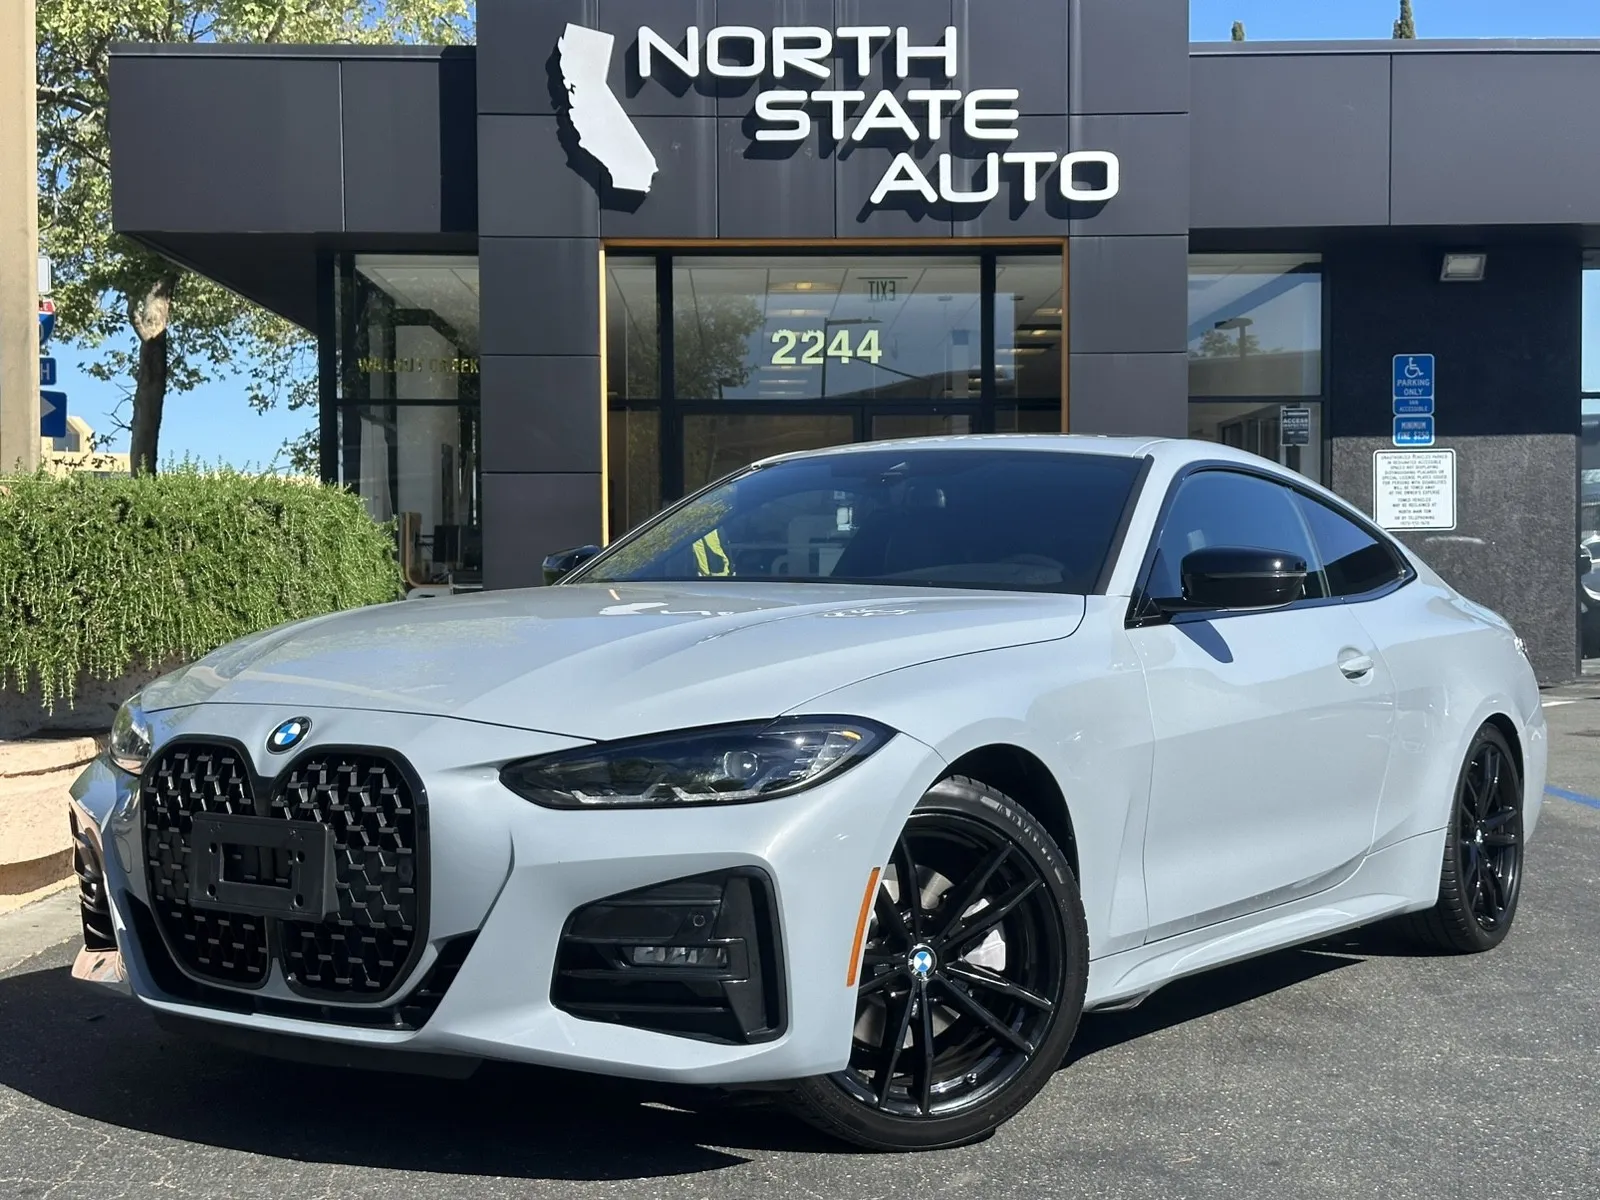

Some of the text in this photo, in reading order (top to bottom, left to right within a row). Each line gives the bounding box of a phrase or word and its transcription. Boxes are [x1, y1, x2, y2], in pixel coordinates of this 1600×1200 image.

[638, 26, 957, 78] NORTH
[755, 89, 1019, 141] STATE
[870, 150, 1120, 204] AUTO
[771, 329, 882, 364] 2244
[1397, 432, 1411, 440] FINE
